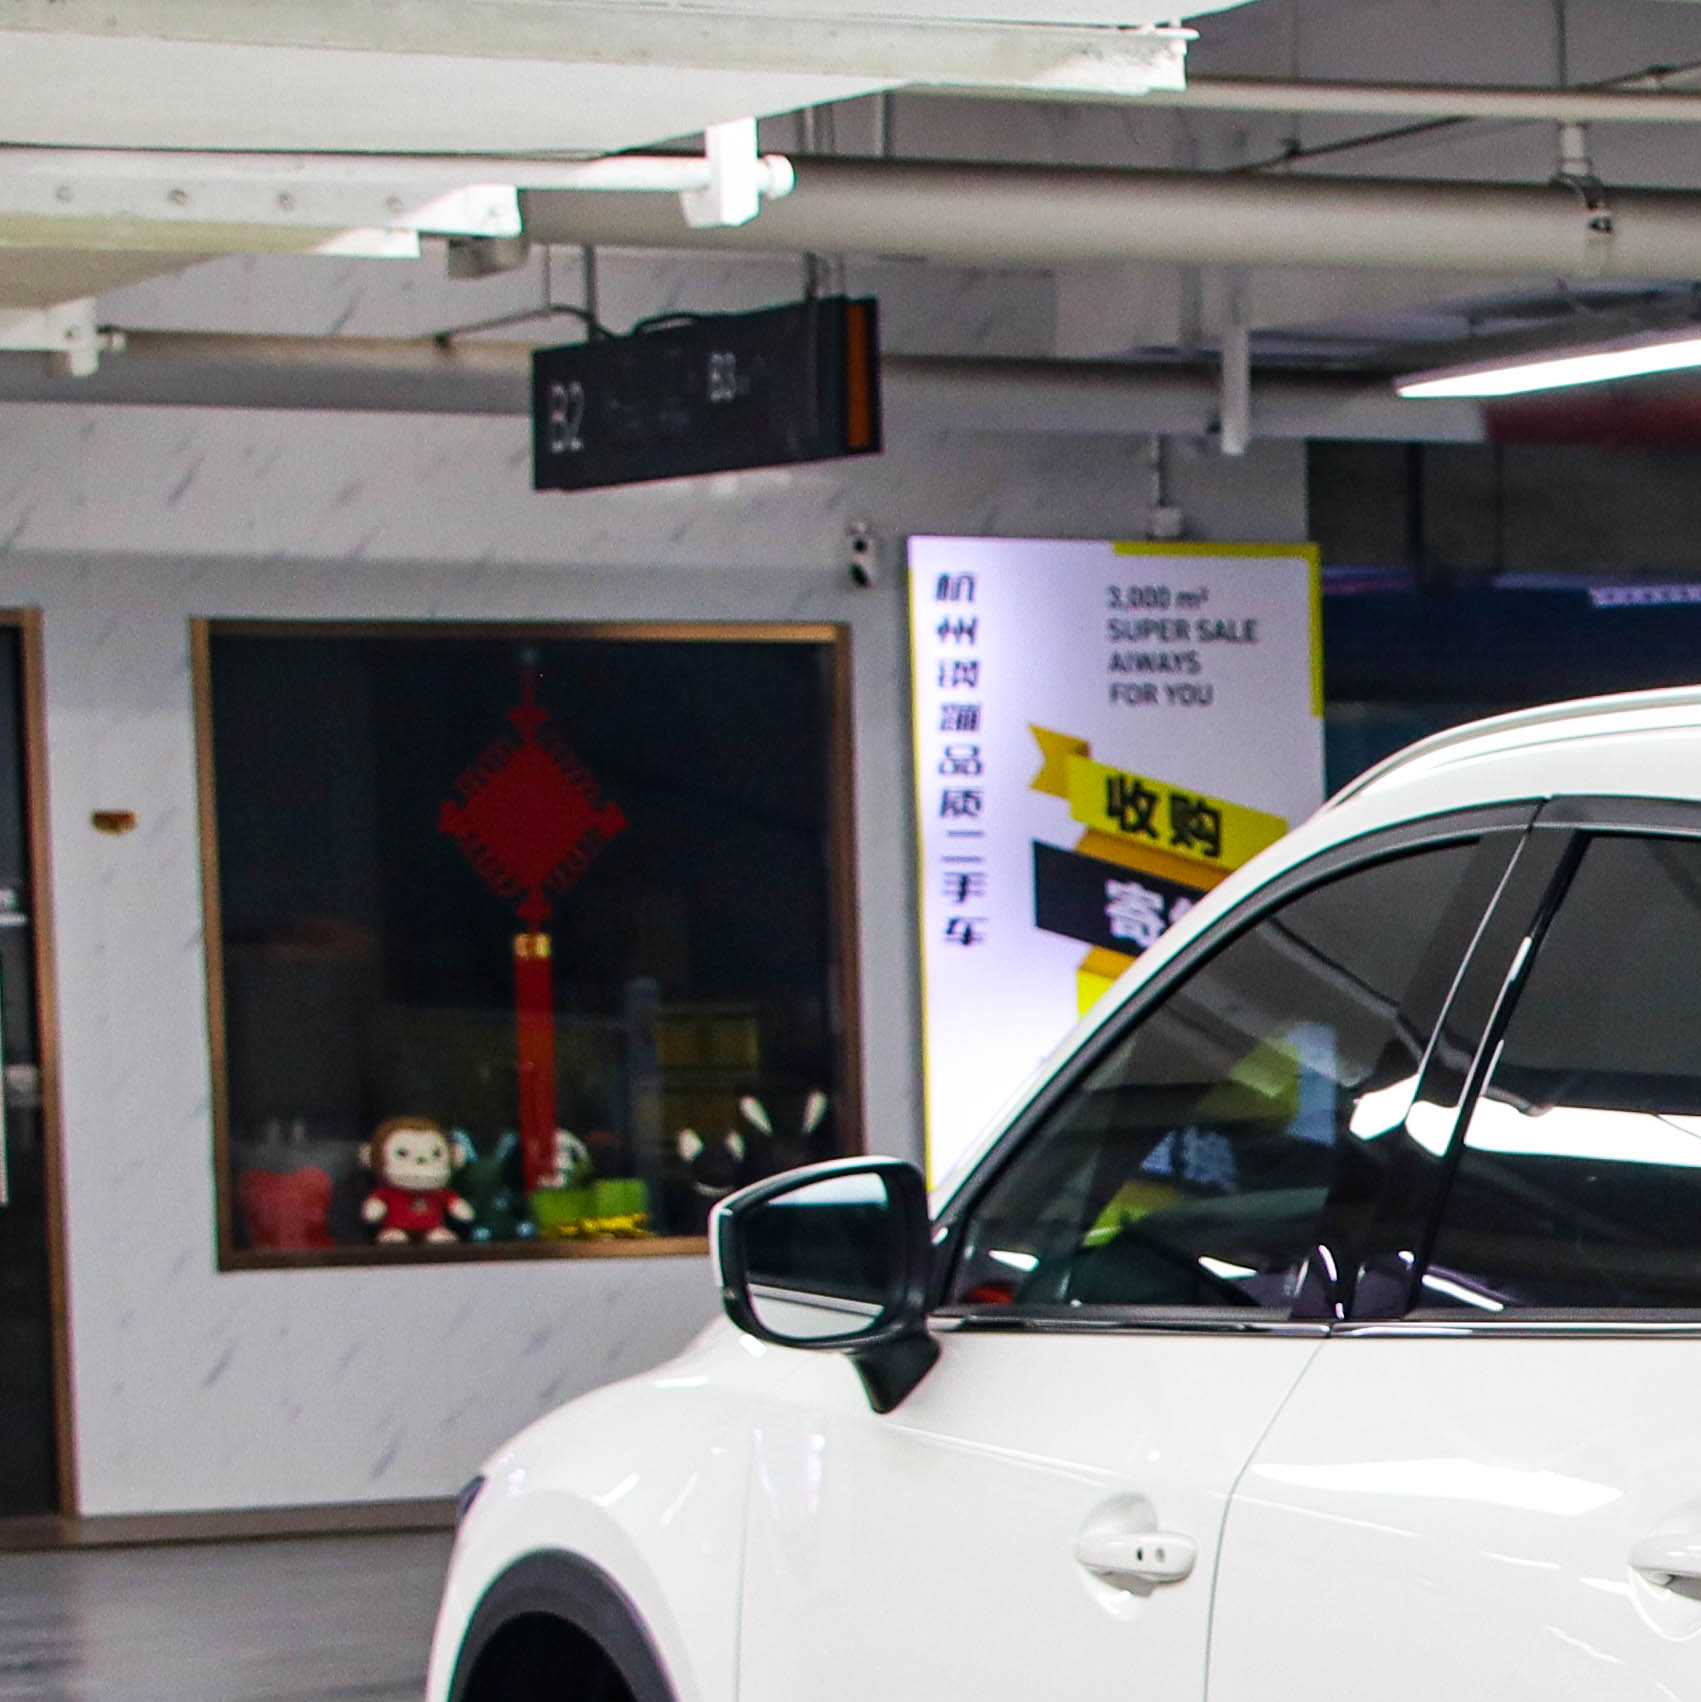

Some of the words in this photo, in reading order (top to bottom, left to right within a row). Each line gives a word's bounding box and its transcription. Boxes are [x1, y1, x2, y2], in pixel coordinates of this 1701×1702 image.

[1107, 617, 1191, 643] SUPER
[1196, 618, 1257, 645] SALE
[1109, 682, 1158, 706] FOR
[1164, 682, 1214, 707] YOU
[1105, 774, 1224, 860] 收购
[1103, 878, 1194, 948] 寄
